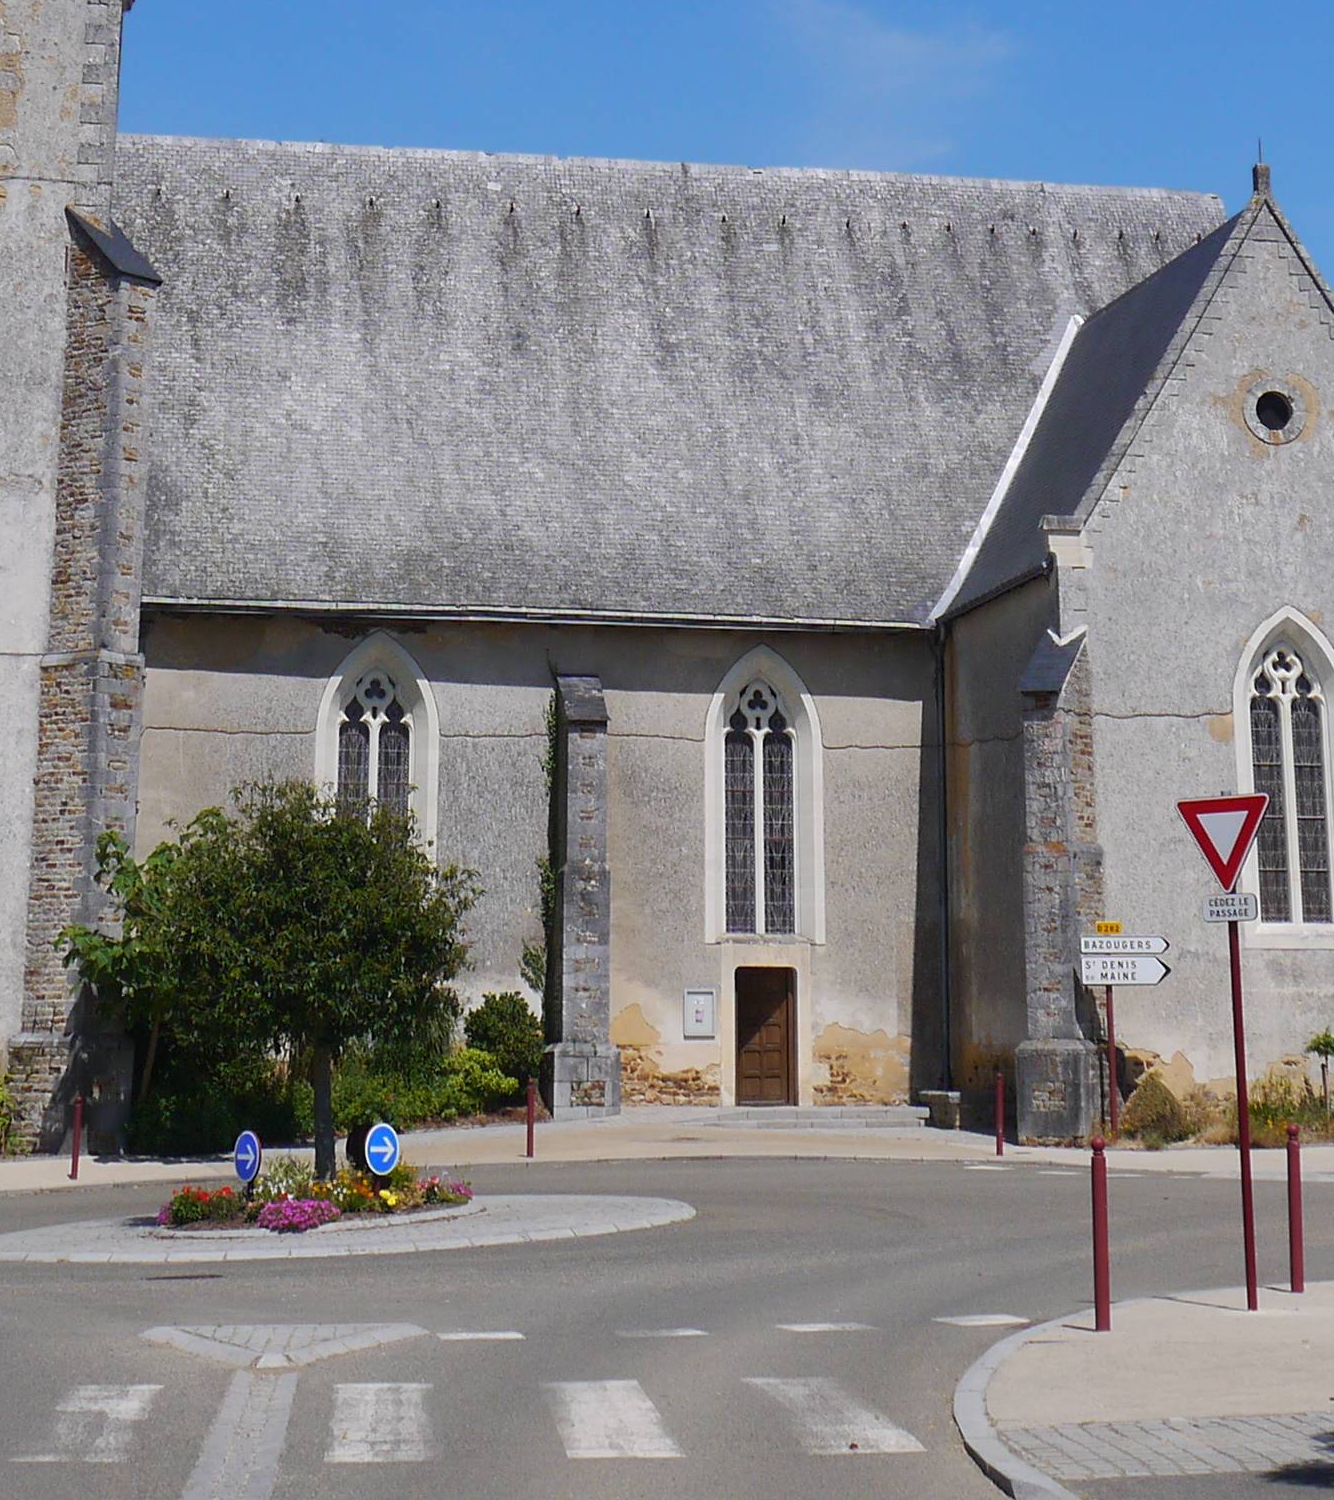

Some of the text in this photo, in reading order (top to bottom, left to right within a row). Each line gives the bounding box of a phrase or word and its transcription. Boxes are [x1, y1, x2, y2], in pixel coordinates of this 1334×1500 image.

[1208, 897, 1249, 908] CÉDEZ LE
[1209, 908, 1249, 918] PASSAGE
[1083, 940, 1152, 949] BAZOUGERS
[1101, 960, 1137, 970] DENIS
[1100, 971, 1137, 981] MAINE
